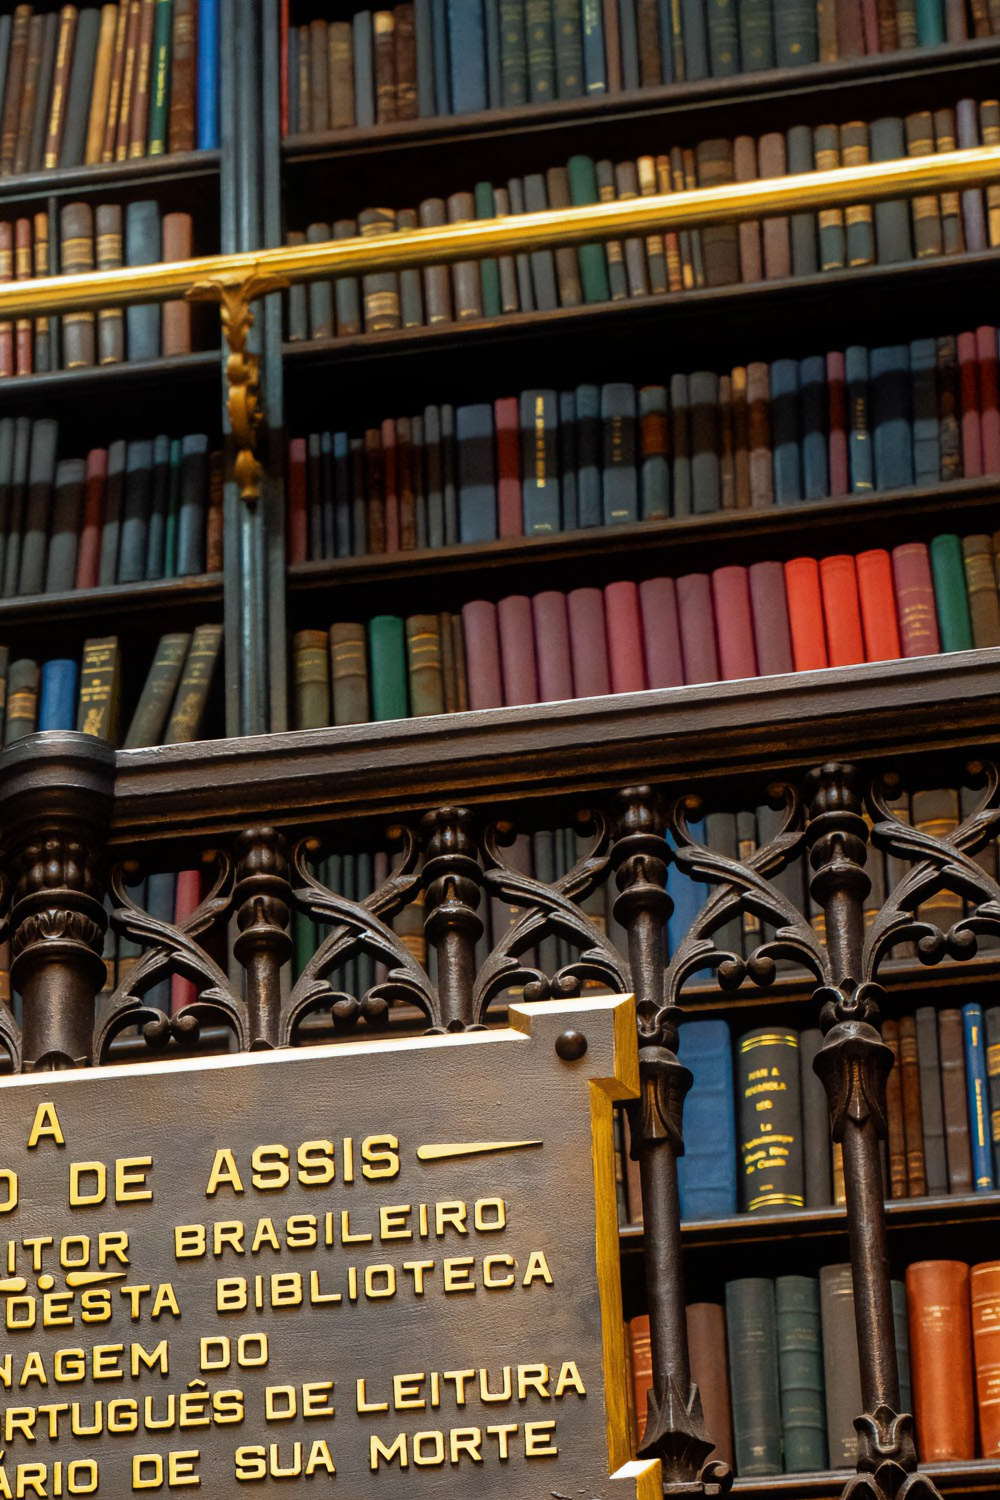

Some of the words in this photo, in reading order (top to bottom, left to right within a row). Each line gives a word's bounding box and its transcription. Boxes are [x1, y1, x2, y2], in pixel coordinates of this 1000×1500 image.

[28, 1101, 66, 1147] A
[69, 1156, 153, 1206] DE
[206, 1134, 400, 1195] ASSIS
[174, 1197, 506, 1258] BRASILEIRO
[6, 1283, 181, 1329] DESTA
[216, 1251, 554, 1311] BIBLIOTECA
[199, 1332, 268, 1370] DO
[265, 1381, 335, 1420] DE
[356, 1361, 587, 1412] LEITURA
[132, 1450, 201, 1489] DE
[234, 1440, 336, 1480] SUA
[369, 1420, 558, 1469] MORTE
